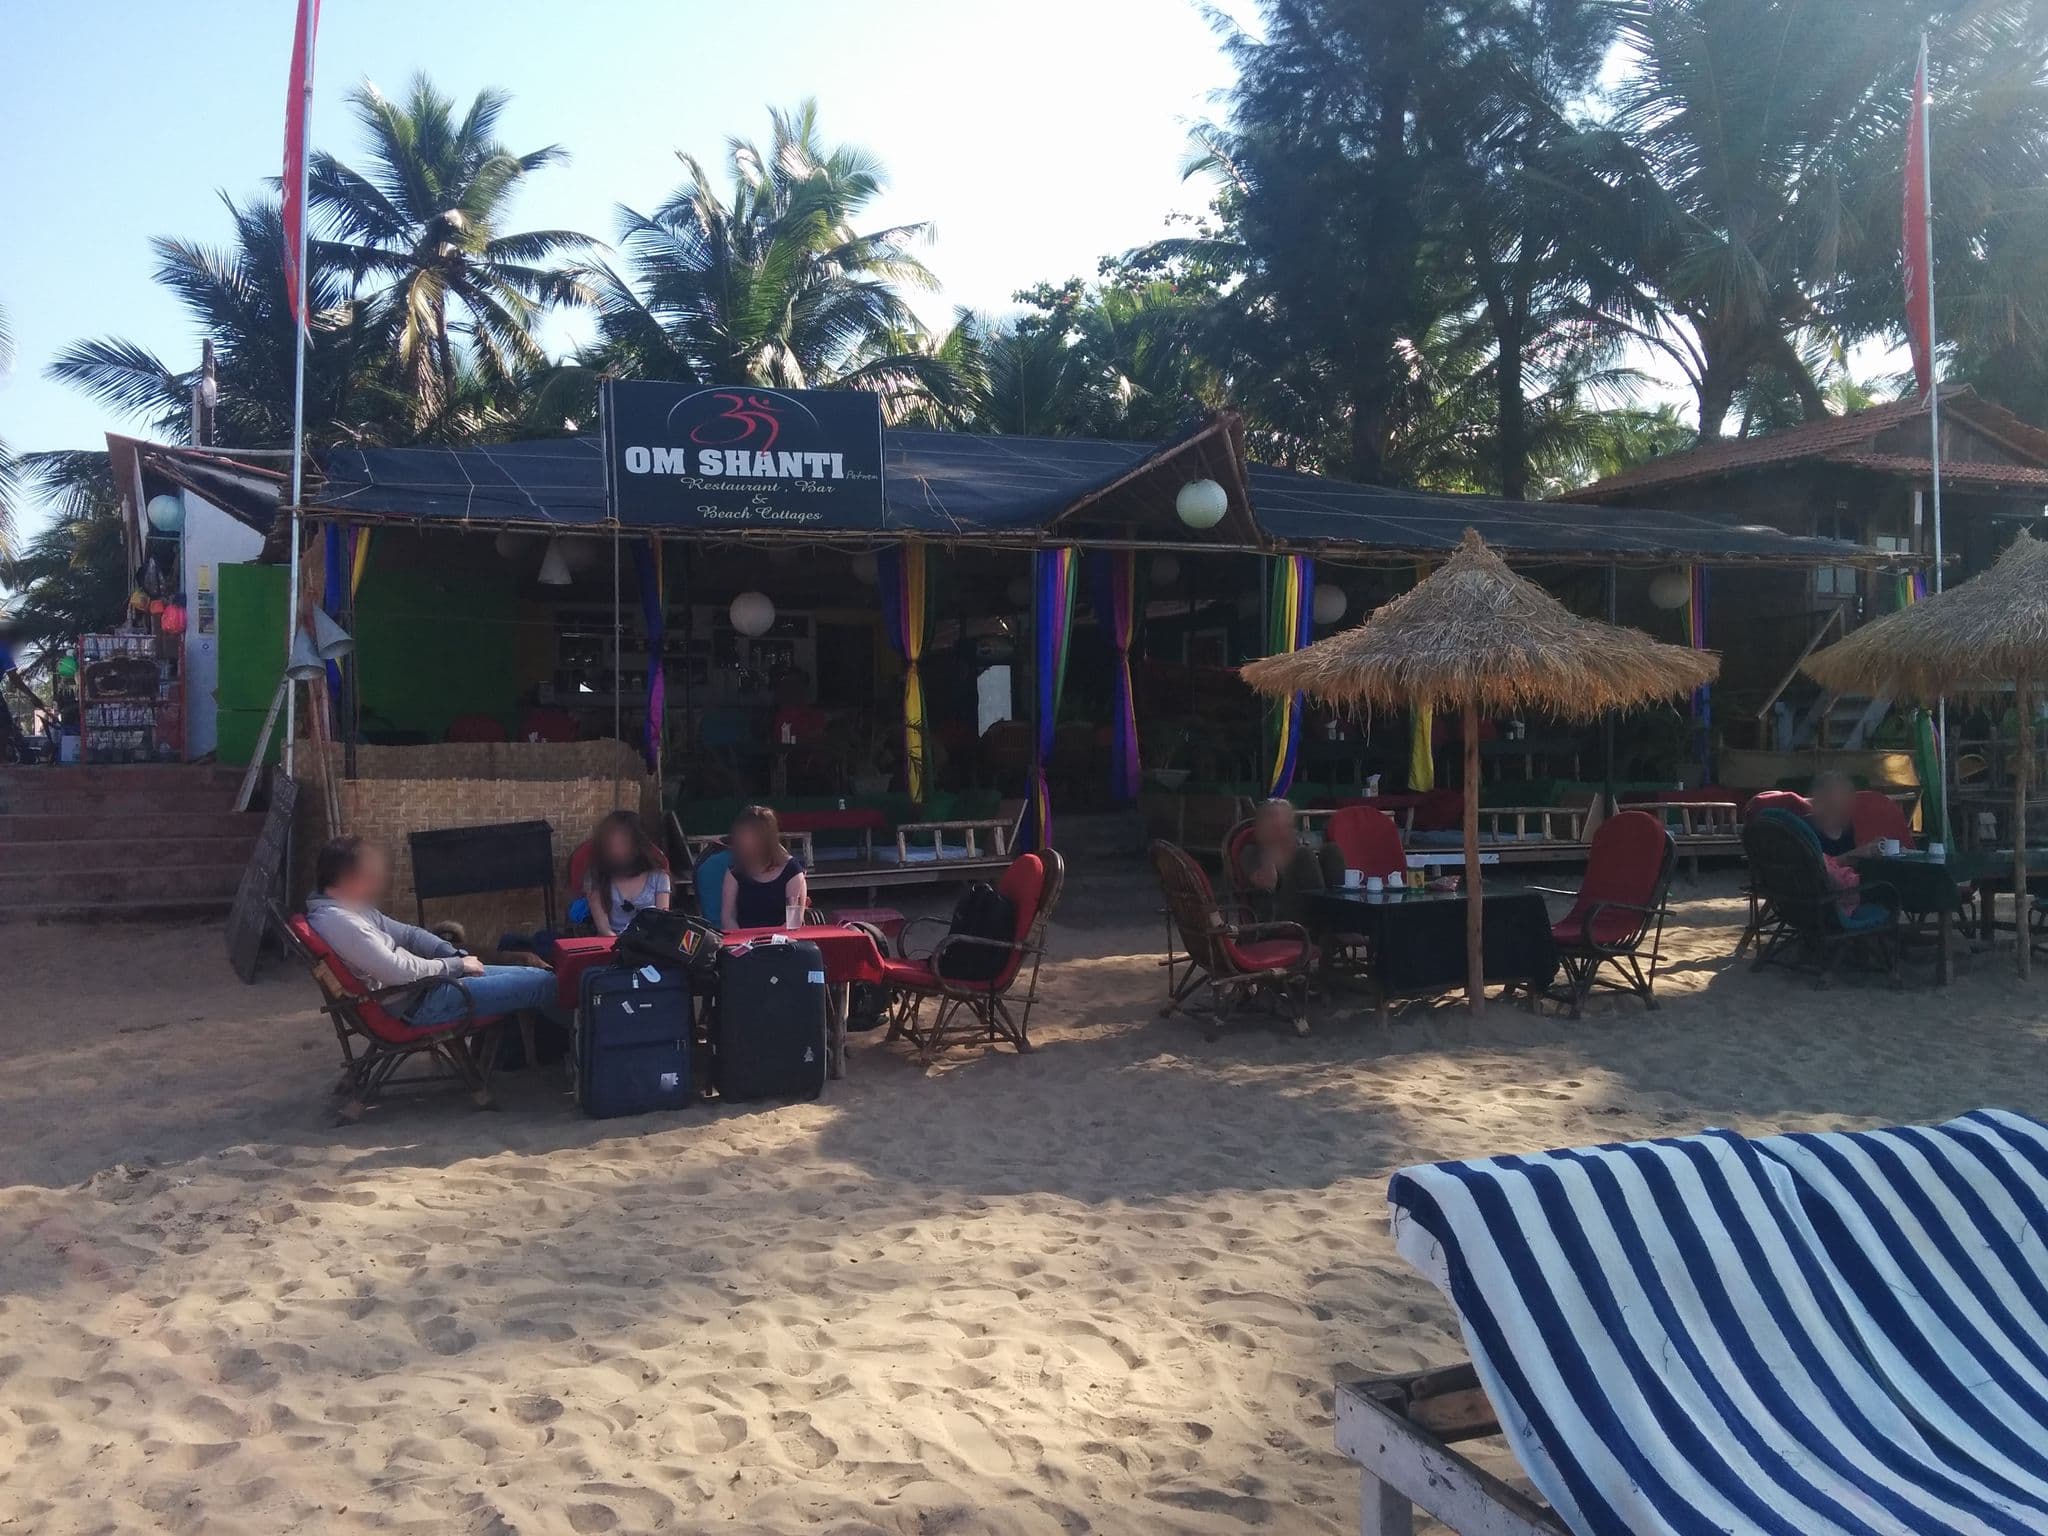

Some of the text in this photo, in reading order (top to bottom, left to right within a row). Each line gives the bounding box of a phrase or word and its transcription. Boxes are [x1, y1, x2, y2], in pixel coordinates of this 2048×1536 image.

[625, 446, 844, 478] OM SHANTI
[795, 480, 836, 493] Bar
[752, 493, 768, 504] &
[697, 505, 824, 524] Beach Cottages
